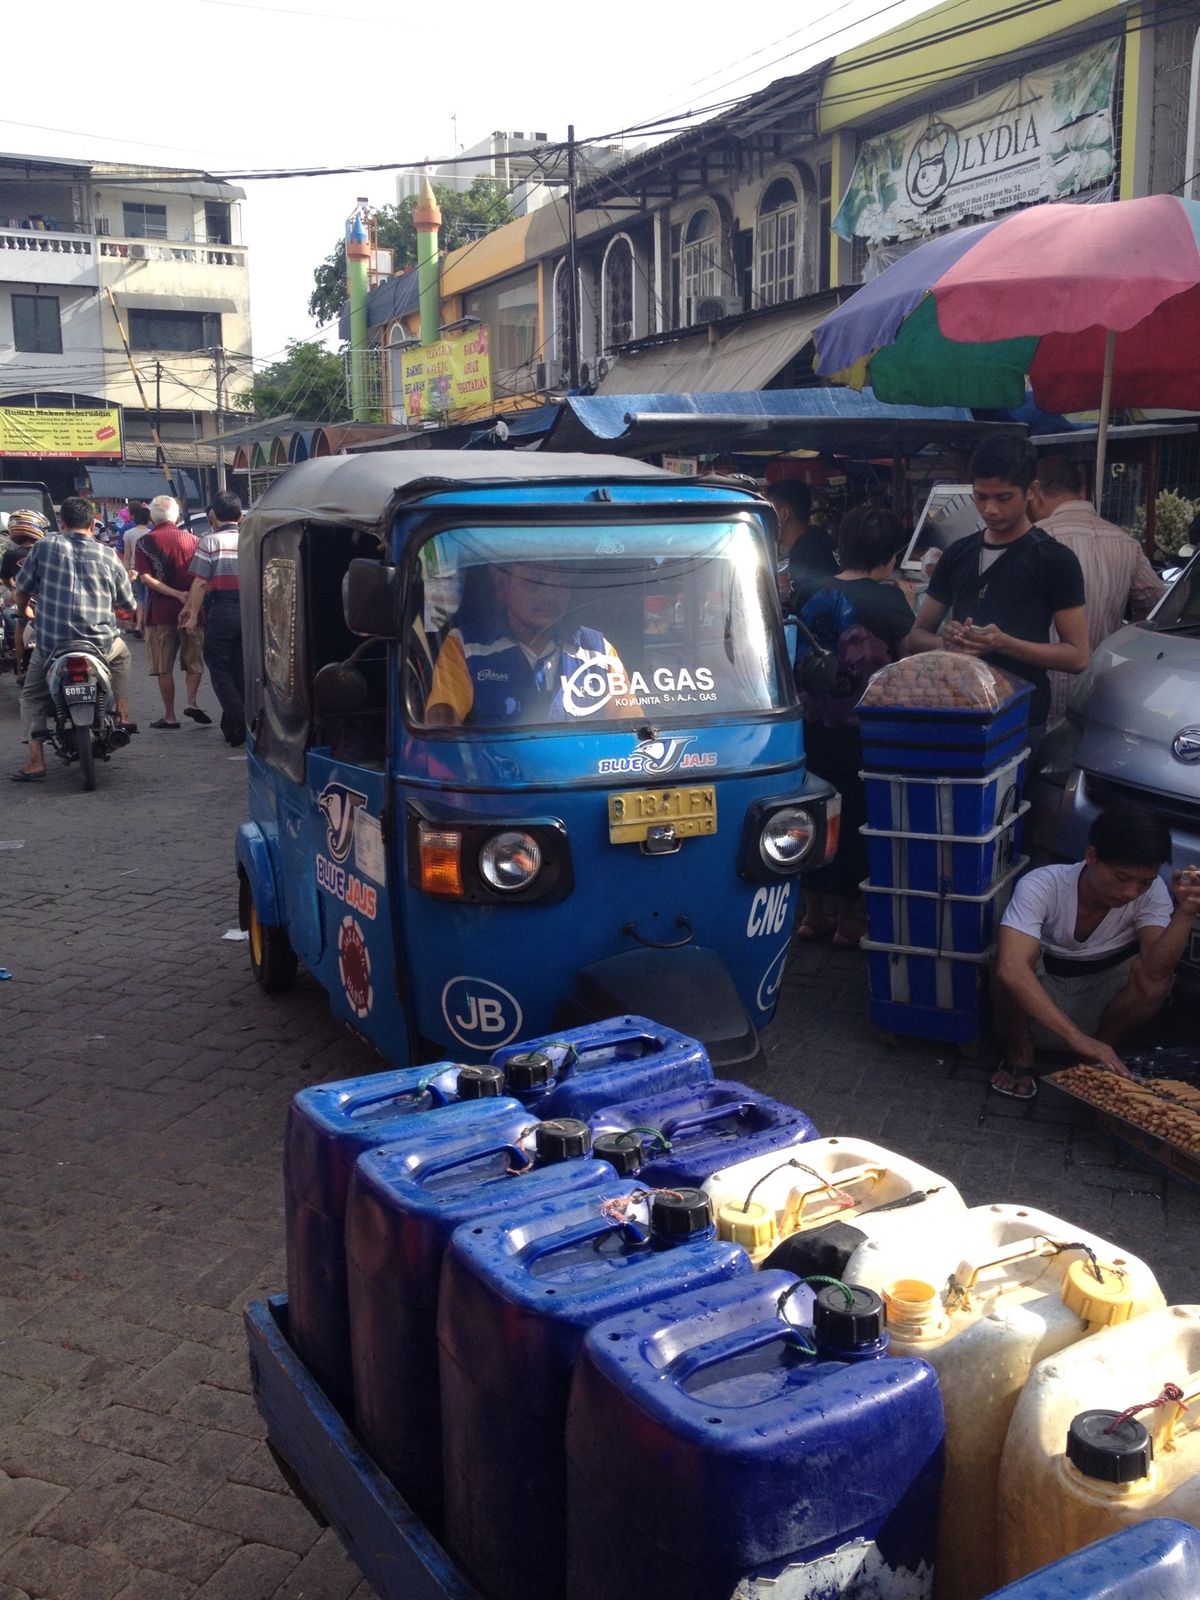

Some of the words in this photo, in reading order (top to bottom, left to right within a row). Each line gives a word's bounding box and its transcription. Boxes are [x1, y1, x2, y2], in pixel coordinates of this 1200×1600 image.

[960, 112, 1040, 172] LYDIA
[561, 671, 650, 699] KOBA
[653, 667, 715, 692] GAS
[700, 692, 717, 702] GAS
[599, 757, 643, 773] BLUE
[613, 796, 626, 823] B
[316, 853, 346, 901] BLUE
[746, 881, 791, 938] CNG
[455, 996, 506, 1032] JB
